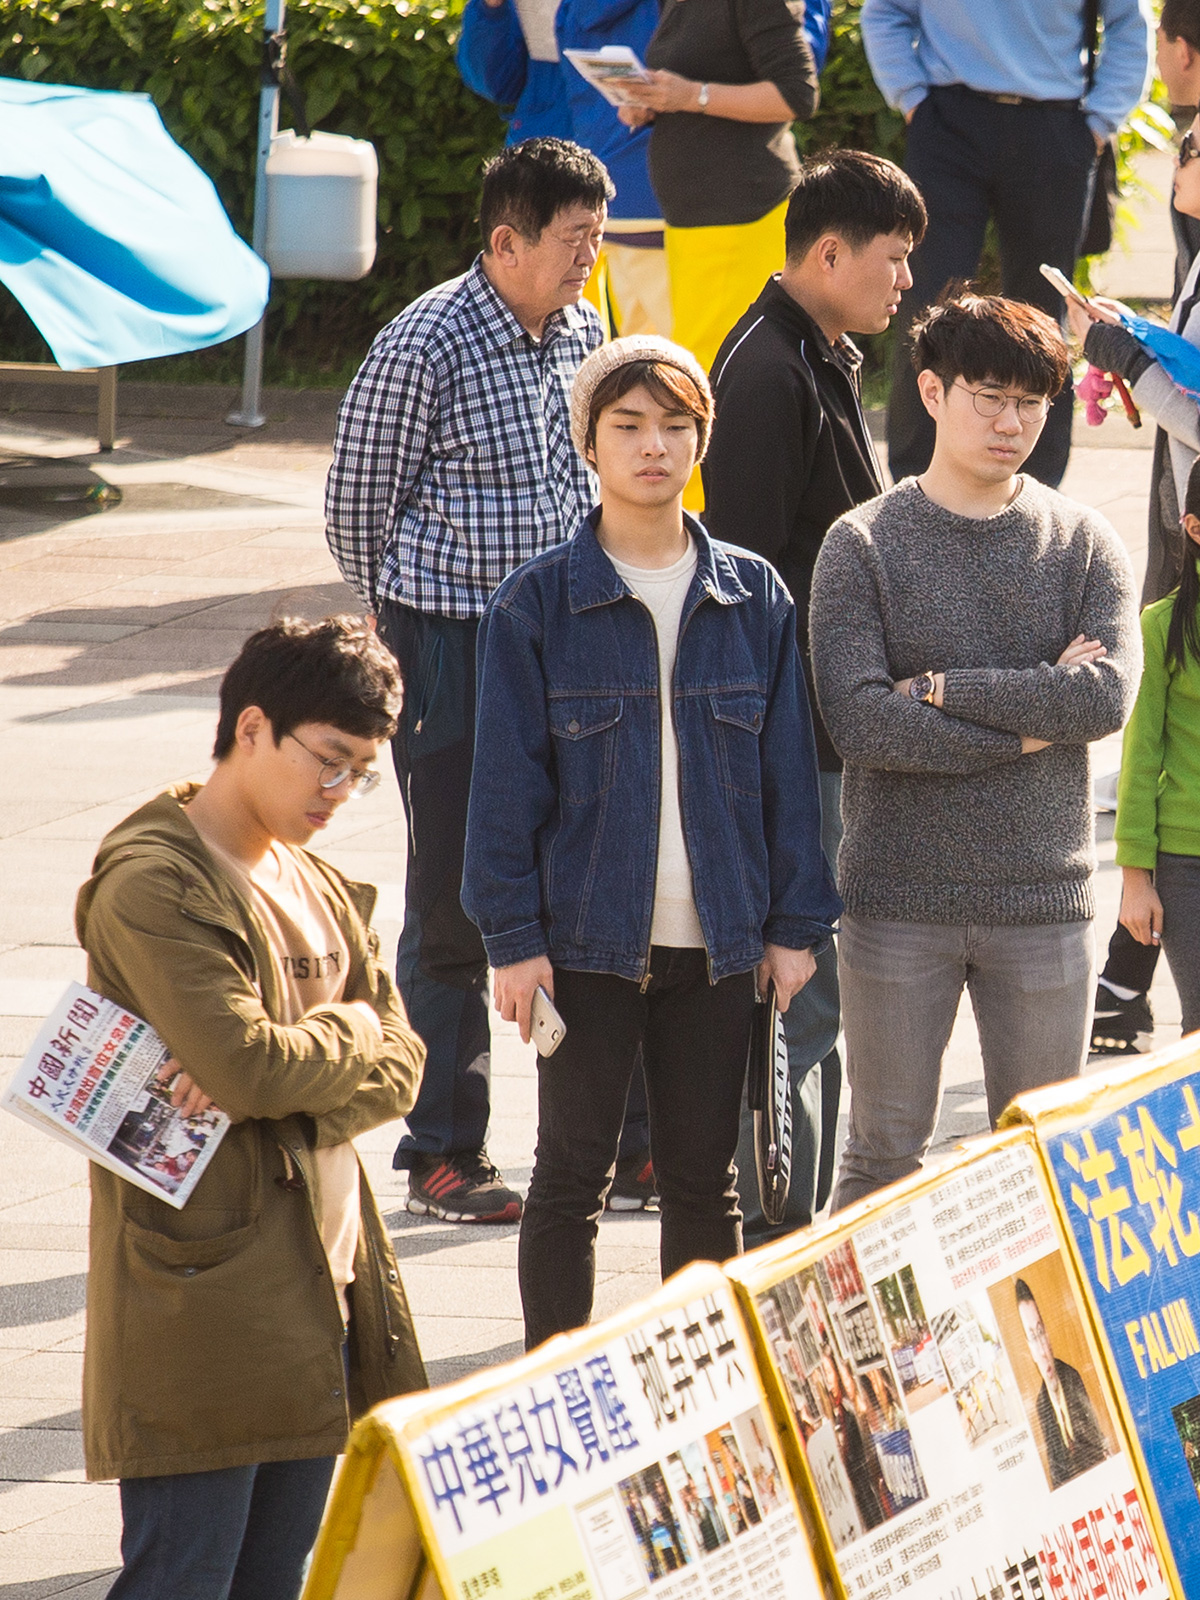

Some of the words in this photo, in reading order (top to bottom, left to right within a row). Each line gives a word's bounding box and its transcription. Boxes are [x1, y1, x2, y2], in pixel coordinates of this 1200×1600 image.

[27, 989, 105, 1101] 中國新聞
[1125, 1311, 1200, 1379] FALUN
[419, 1354, 639, 1535] 中華兒女覺醒
